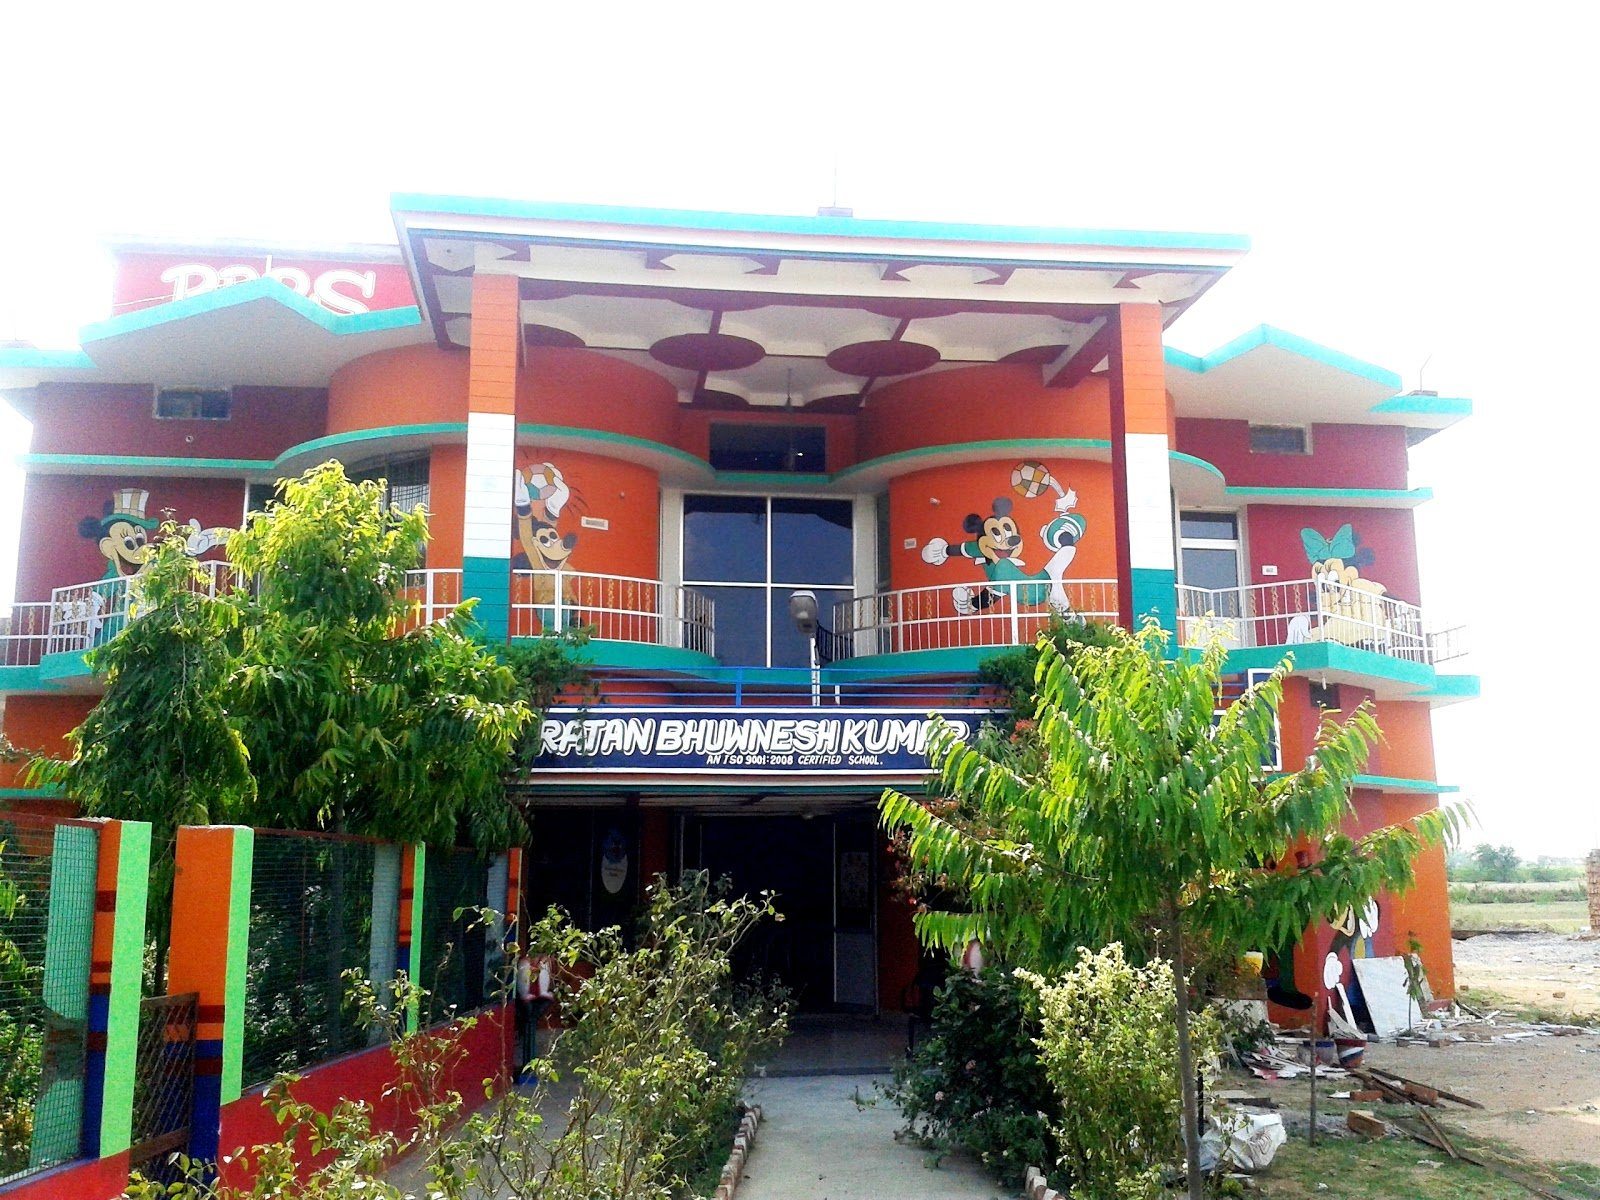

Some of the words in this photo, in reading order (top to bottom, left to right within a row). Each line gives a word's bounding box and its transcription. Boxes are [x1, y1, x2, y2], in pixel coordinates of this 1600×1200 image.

[536, 718, 656, 756] RATAN
[655, 718, 842, 755] BHUWNESH
[706, 755, 721, 765] AN
[723, 755, 742, 765] ISO
[744, 755, 794, 766] 9001:2008
[797, 755, 842, 766] CERTIFIED
